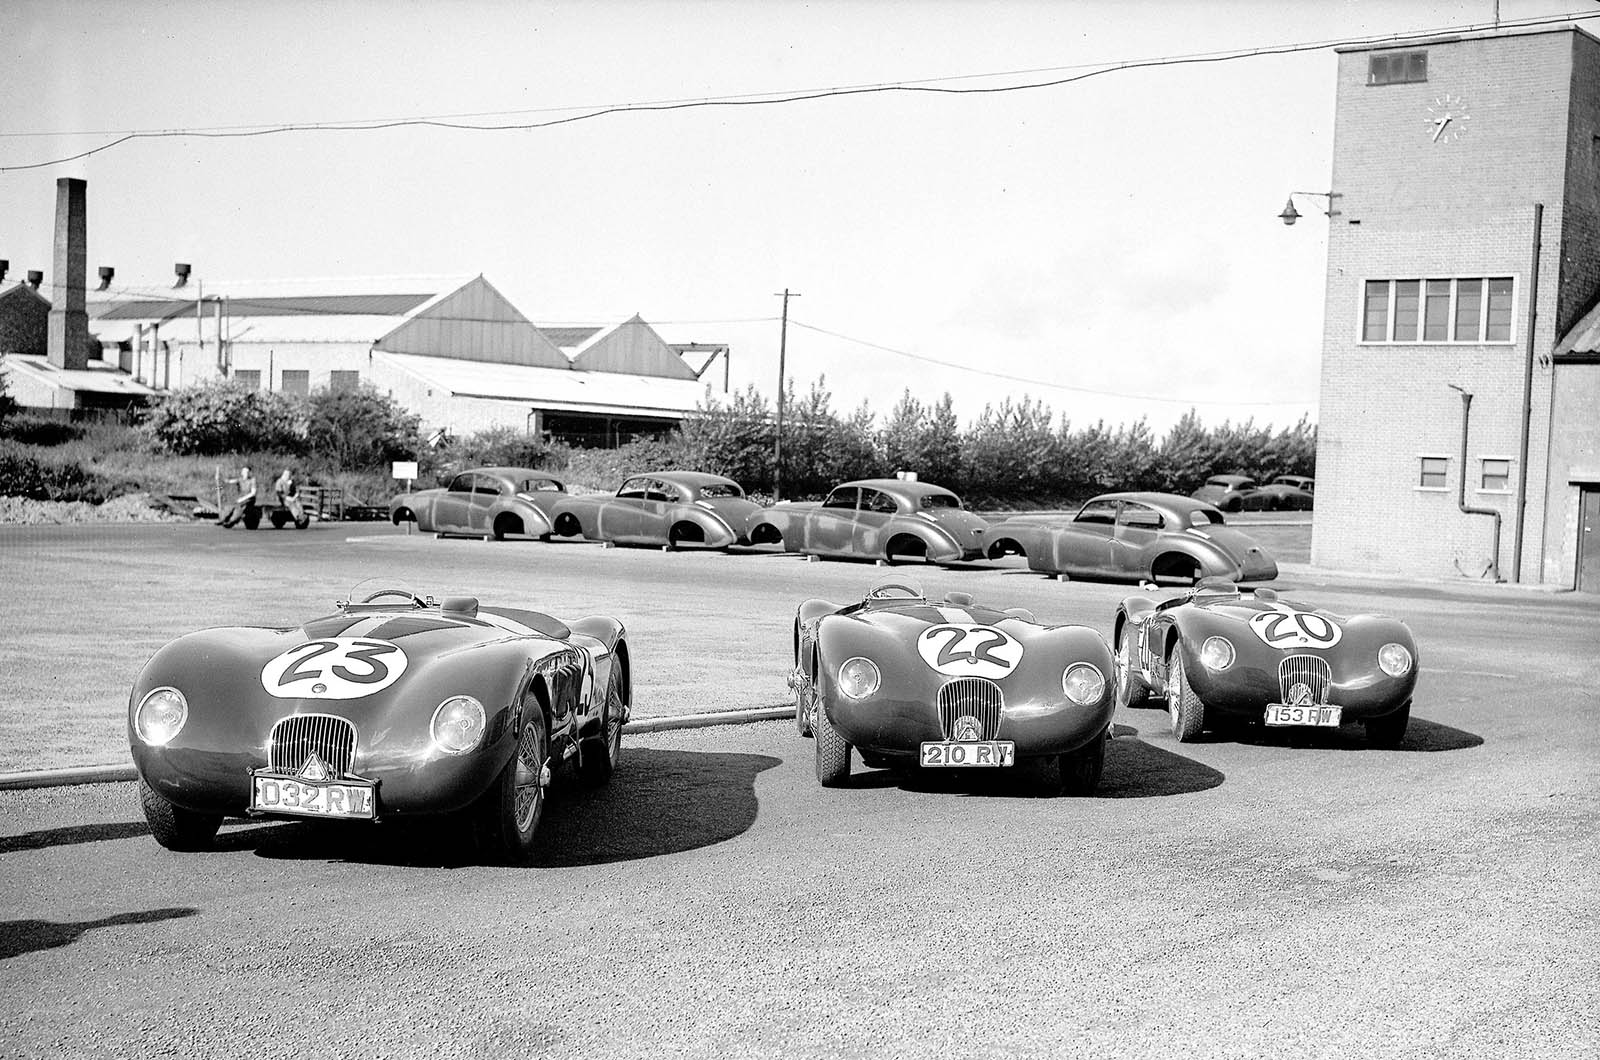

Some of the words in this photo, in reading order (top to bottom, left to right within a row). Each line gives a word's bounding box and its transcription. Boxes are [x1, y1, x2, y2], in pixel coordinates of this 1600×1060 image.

[1256, 613, 1334, 642] 20
[927, 627, 1010, 668] 22
[278, 641, 398, 686] 23
[1274, 707, 1304, 722] 153
[927, 746, 965, 763] 210
[326, 787, 367, 815] RW
